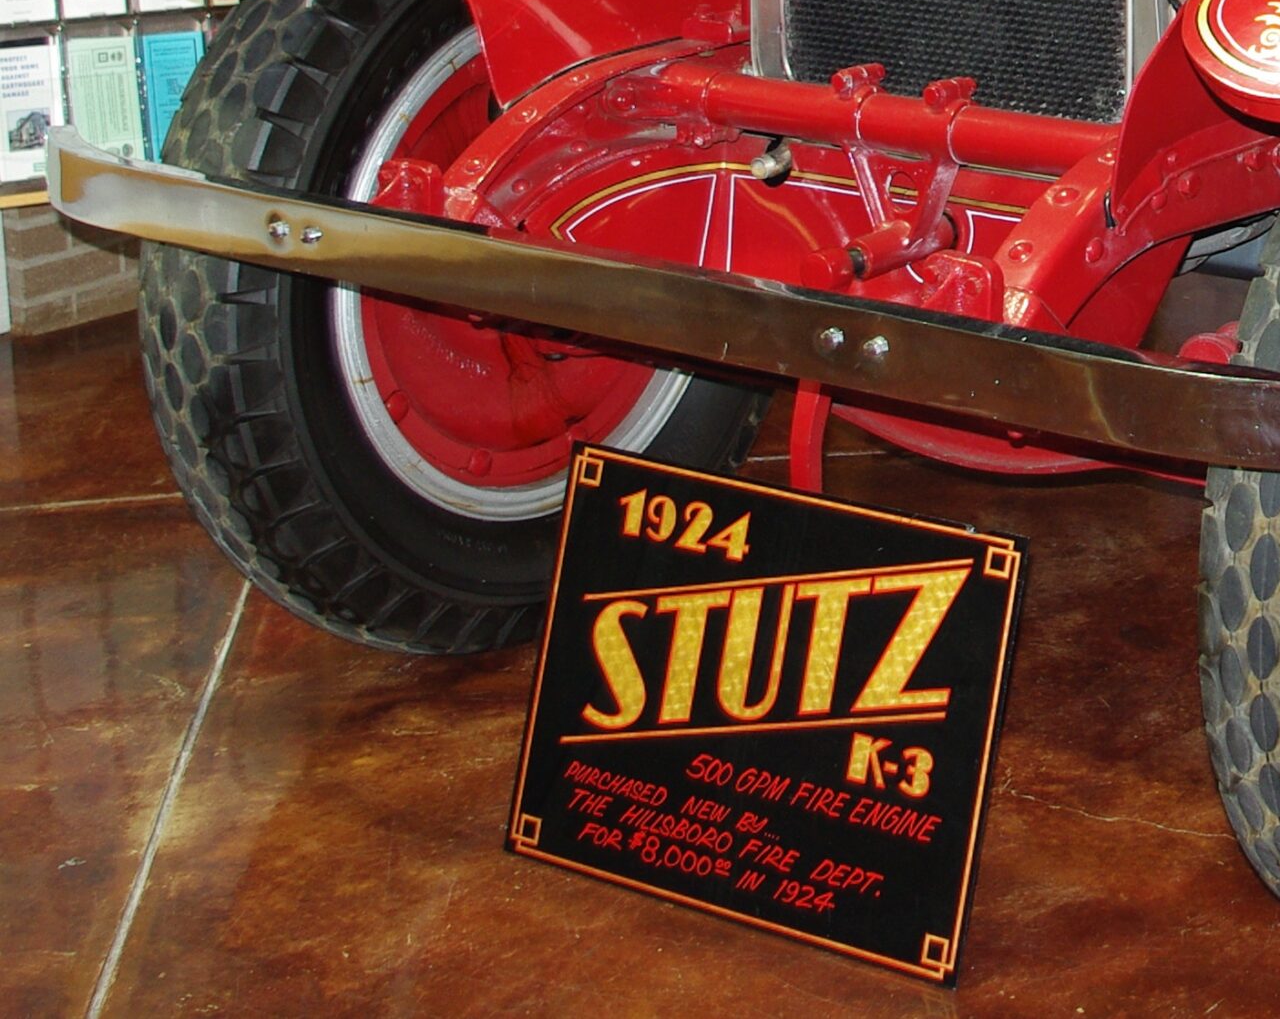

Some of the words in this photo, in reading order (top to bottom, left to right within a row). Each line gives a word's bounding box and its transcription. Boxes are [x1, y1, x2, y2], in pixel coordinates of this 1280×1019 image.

[619, 488, 752, 564] 1924
[580, 568, 974, 733] STUTZ
[563, 760, 669, 807] PURCHASED
[680, 795, 732, 824] NEW
[685, 752, 735, 788] 500
[735, 767, 792, 802] GPM
[790, 781, 852, 818] FIRE
[849, 798, 943, 843] ENGINE
[845, 730, 935, 799] K-3
[567, 788, 614, 819] THE
[619, 804, 734, 854] HILLSBORO
[738, 837, 801, 874] FIRE
[809, 858, 886, 898] DEPT.
[577, 821, 624, 852] FOR
[735, 869, 767, 892] IN
